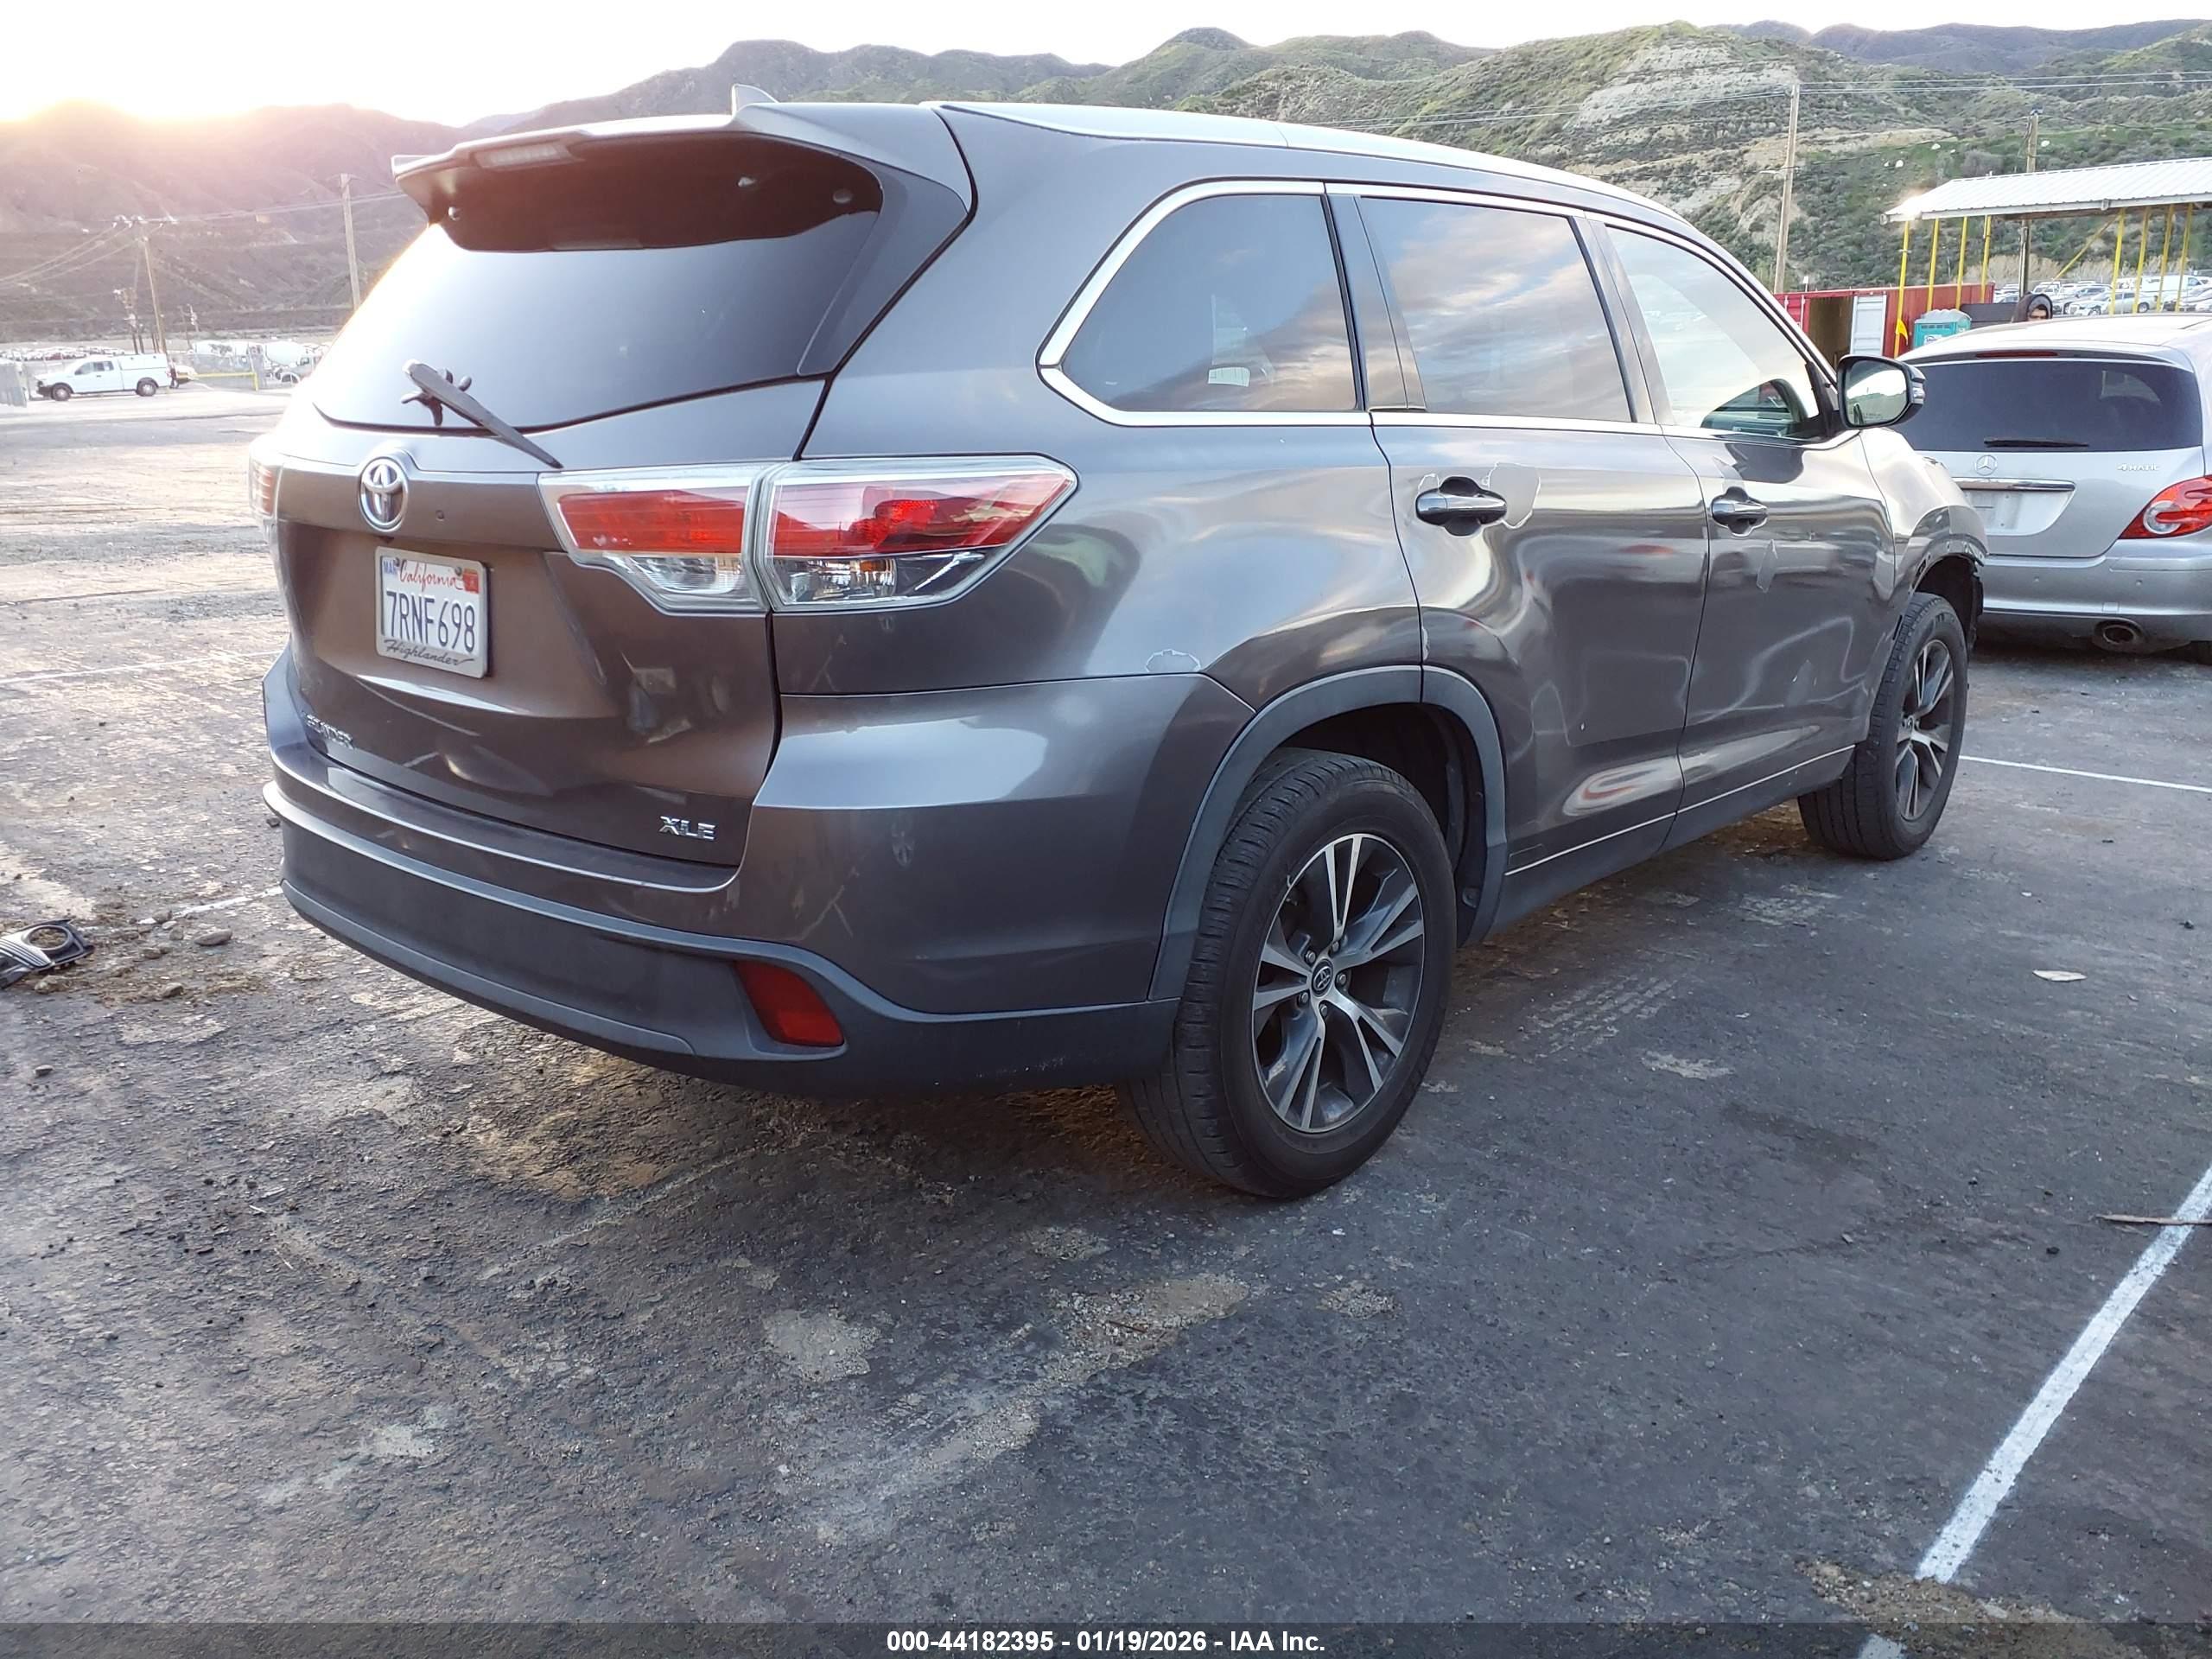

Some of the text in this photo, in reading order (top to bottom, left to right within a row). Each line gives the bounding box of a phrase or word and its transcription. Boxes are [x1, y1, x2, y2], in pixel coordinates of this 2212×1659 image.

[400, 559, 463, 592] California
[386, 590, 475, 653] 7RNF698
[384, 639, 474, 666] Highlander
[658, 815, 716, 841] XLE
